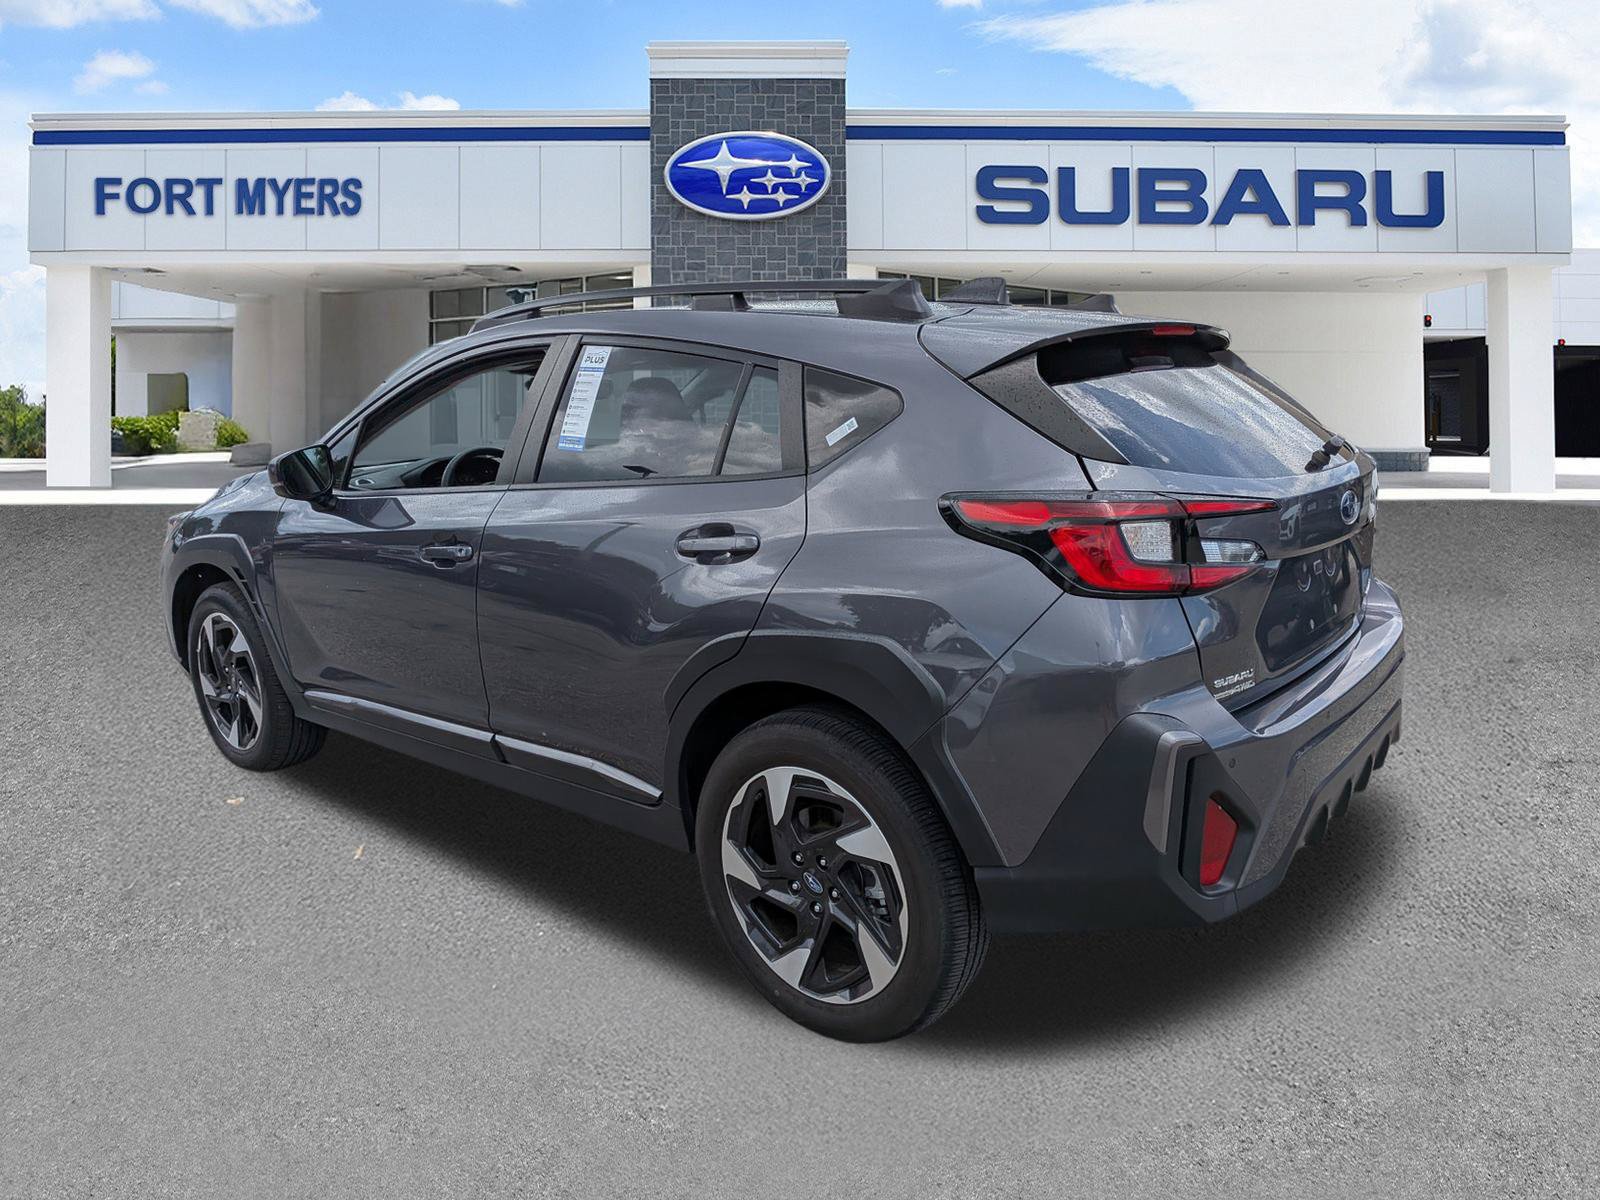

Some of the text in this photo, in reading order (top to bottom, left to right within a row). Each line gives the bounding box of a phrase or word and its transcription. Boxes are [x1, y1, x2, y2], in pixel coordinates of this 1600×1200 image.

[94, 177, 363, 217] FORT MYERS
[975, 165, 1446, 228] SUBARU
[1213, 668, 1254, 688] SUBARU
